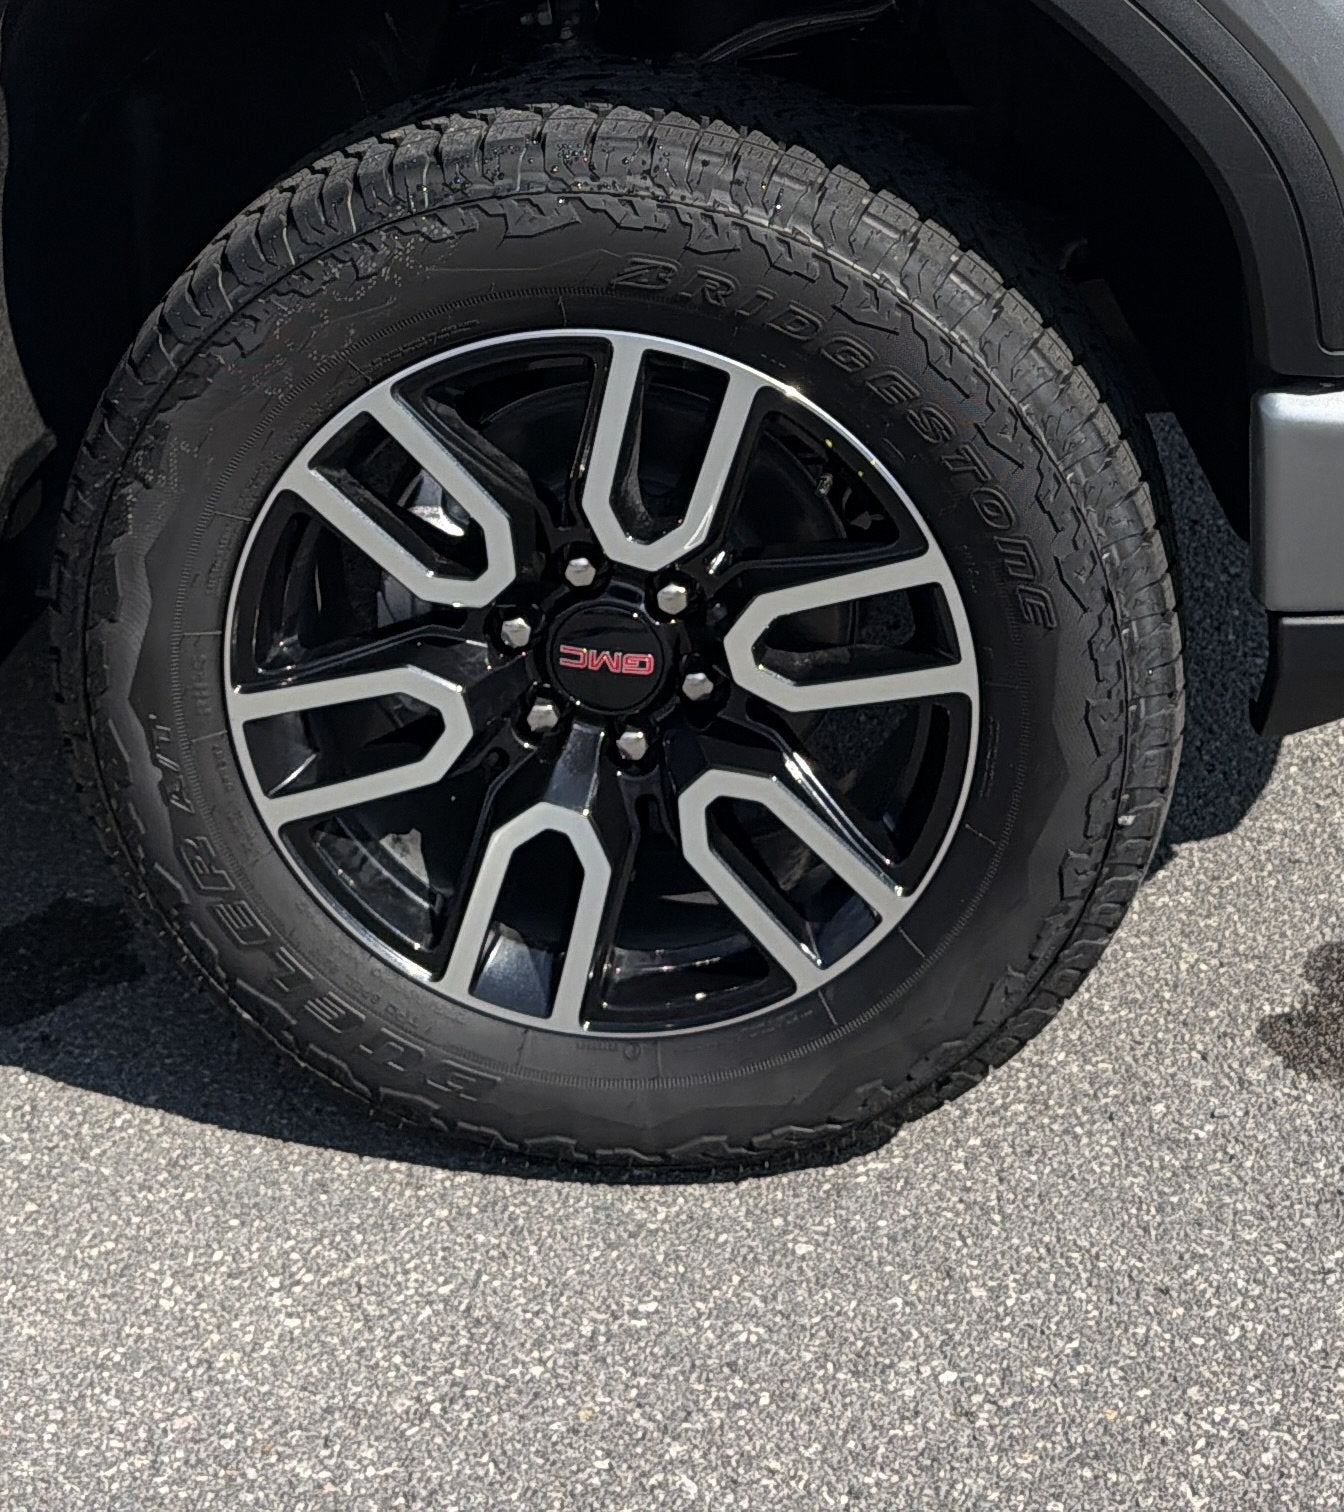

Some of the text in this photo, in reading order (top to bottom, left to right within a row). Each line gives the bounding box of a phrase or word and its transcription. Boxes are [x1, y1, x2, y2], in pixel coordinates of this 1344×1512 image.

[611, 253, 1057, 630] BRIDGESTONE
[559, 643, 655, 676] GMC
[177, 834, 503, 1103] DUELER
